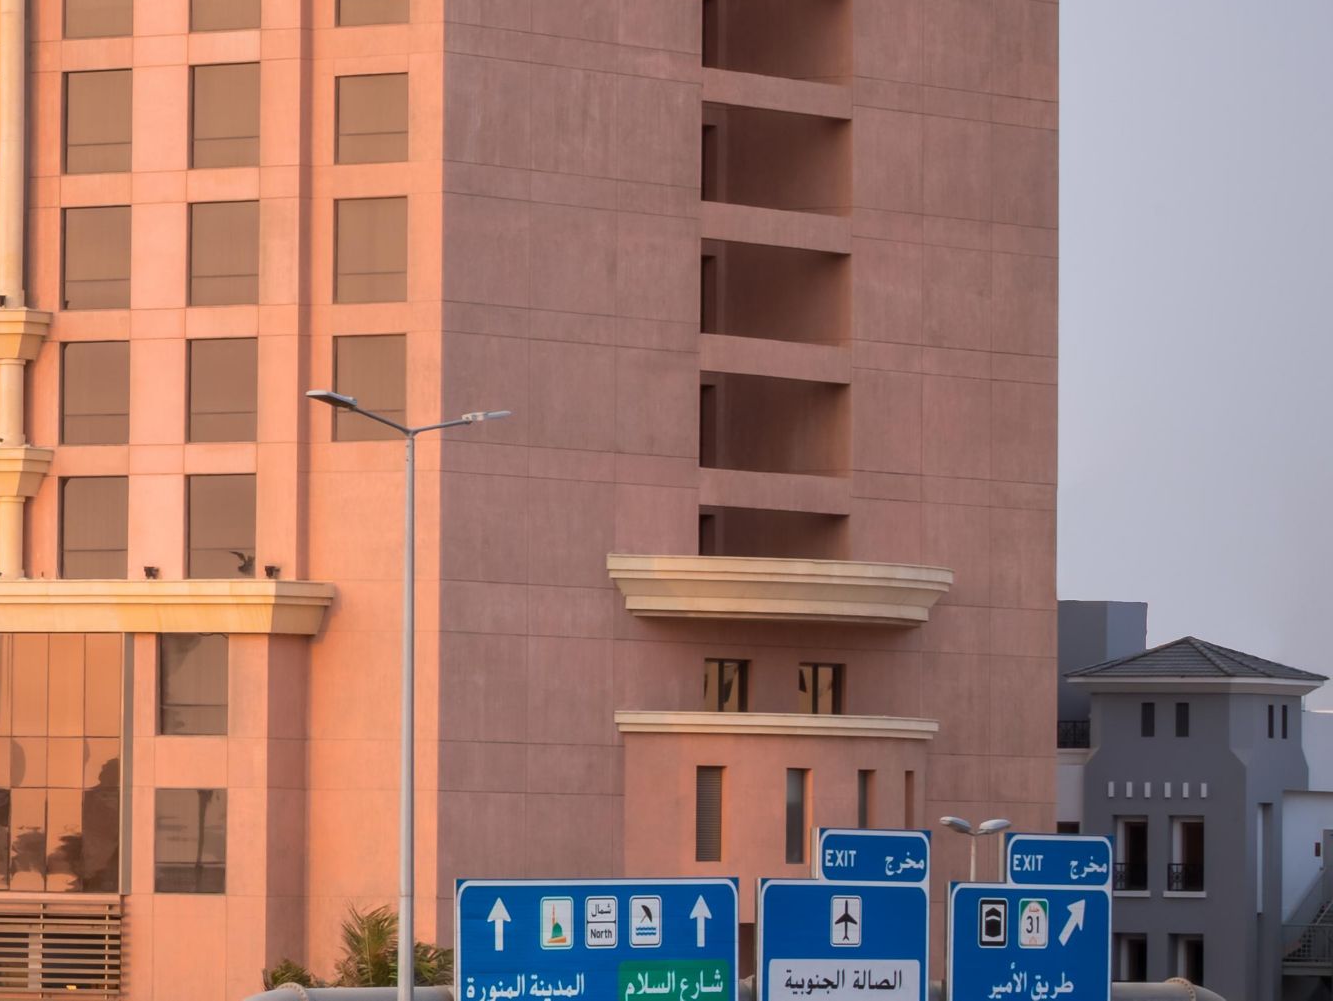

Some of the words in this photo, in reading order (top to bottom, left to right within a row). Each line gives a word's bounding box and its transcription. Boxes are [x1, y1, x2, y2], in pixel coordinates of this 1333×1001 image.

[824, 849, 857, 868] EXIT
[884, 851, 925, 876] مخرج
[1012, 854, 1044, 872] EXIT
[1069, 856, 1108, 879] مخرج
[590, 903, 612, 918] شمال
[590, 928, 613, 939] North
[1025, 915, 1041, 934] 31
[466, 975, 526, 1001] المنورة
[529, 972, 585, 1001] المدينة
[625, 970, 675, 1001] السلام
[679, 969, 724, 1001] شارع
[785, 968, 845, 995] الجنوبية
[852, 969, 902, 990] الصالة
[987, 961, 1028, 999] الأمير
[1030, 971, 1074, 1001] طريق
